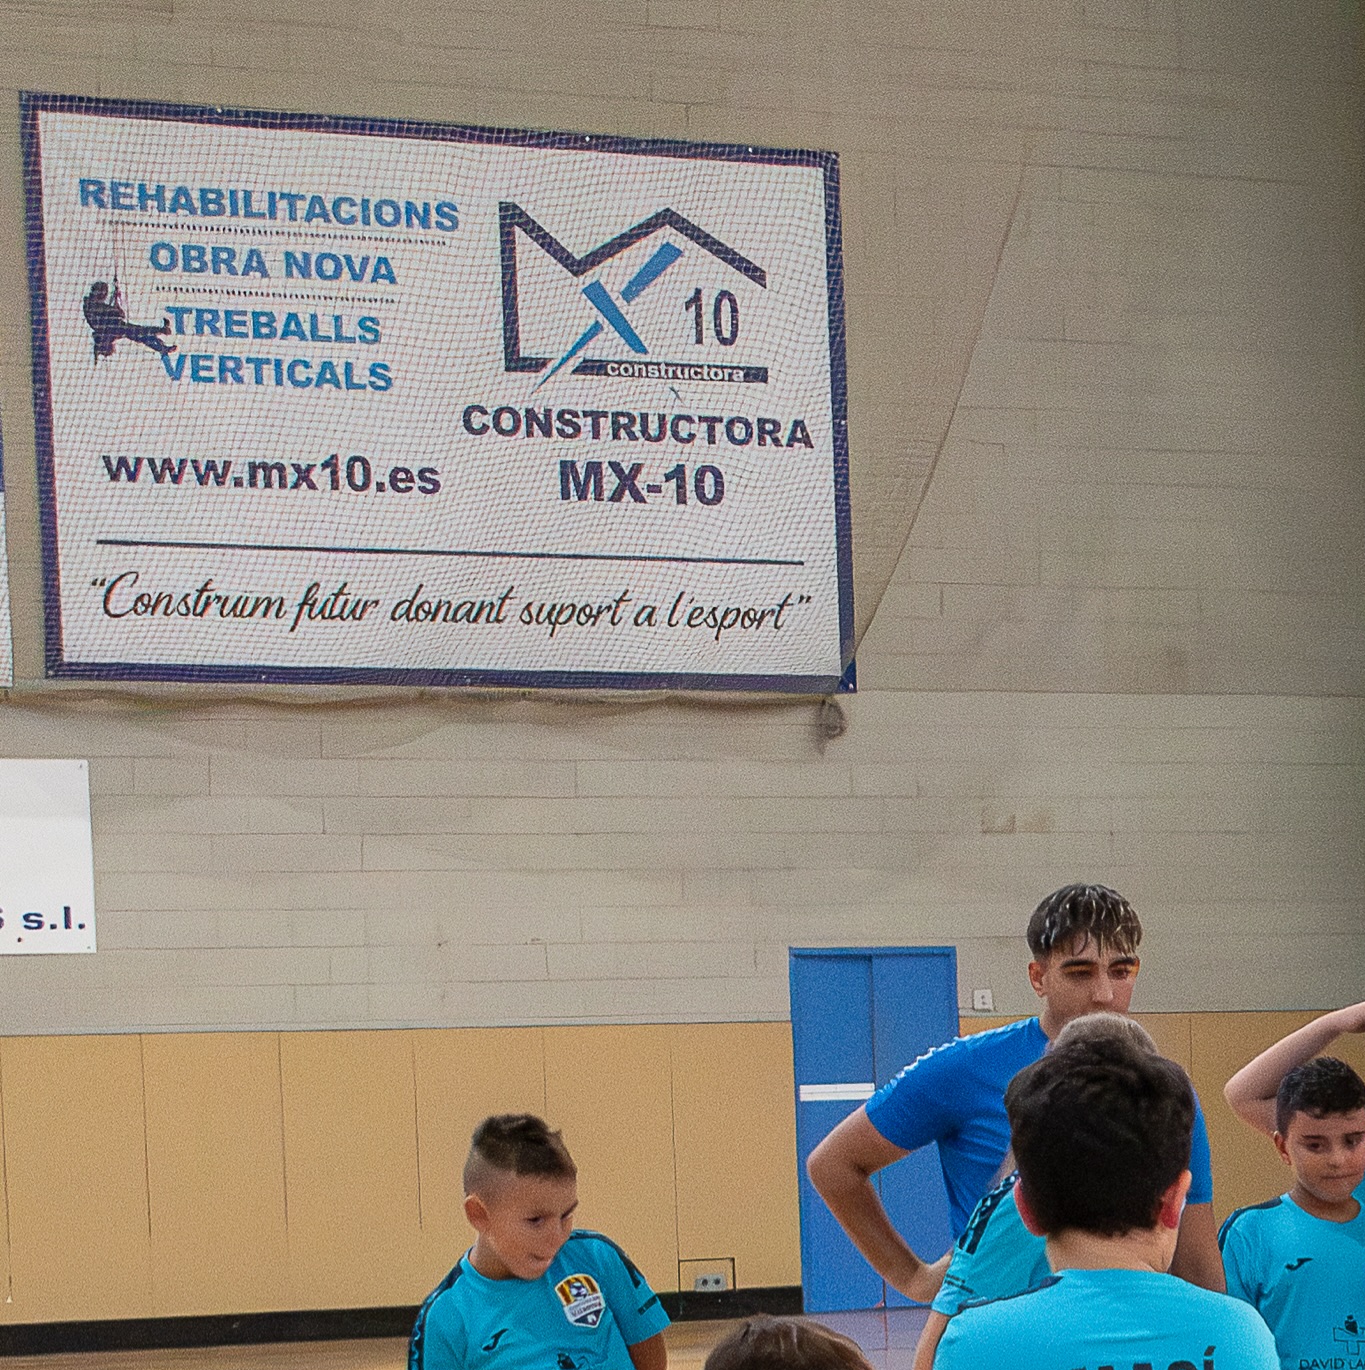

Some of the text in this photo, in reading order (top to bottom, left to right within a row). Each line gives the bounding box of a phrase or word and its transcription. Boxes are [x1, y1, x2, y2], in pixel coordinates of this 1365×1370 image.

[79, 178, 460, 232] REHABILITACIONS
[149, 242, 398, 285] OBRA NOVA
[166, 306, 382, 345] TREBALLS
[685, 287, 740, 347] 10
[160, 352, 394, 392] VERTICALS
[606, 361, 745, 382] constructora
[462, 403, 815, 449] CONSTRUCTORA
[102, 453, 442, 495] www.mx10.es
[559, 459, 726, 506] MX-10
[289, 582, 379, 633] futur
[390, 584, 516, 624] donant
[518, 587, 632, 638] suport
[633, 603, 657, 628] a
[22, 905, 86, 931] s.l.
[1298, 1358, 1345, 1370] DAVID
